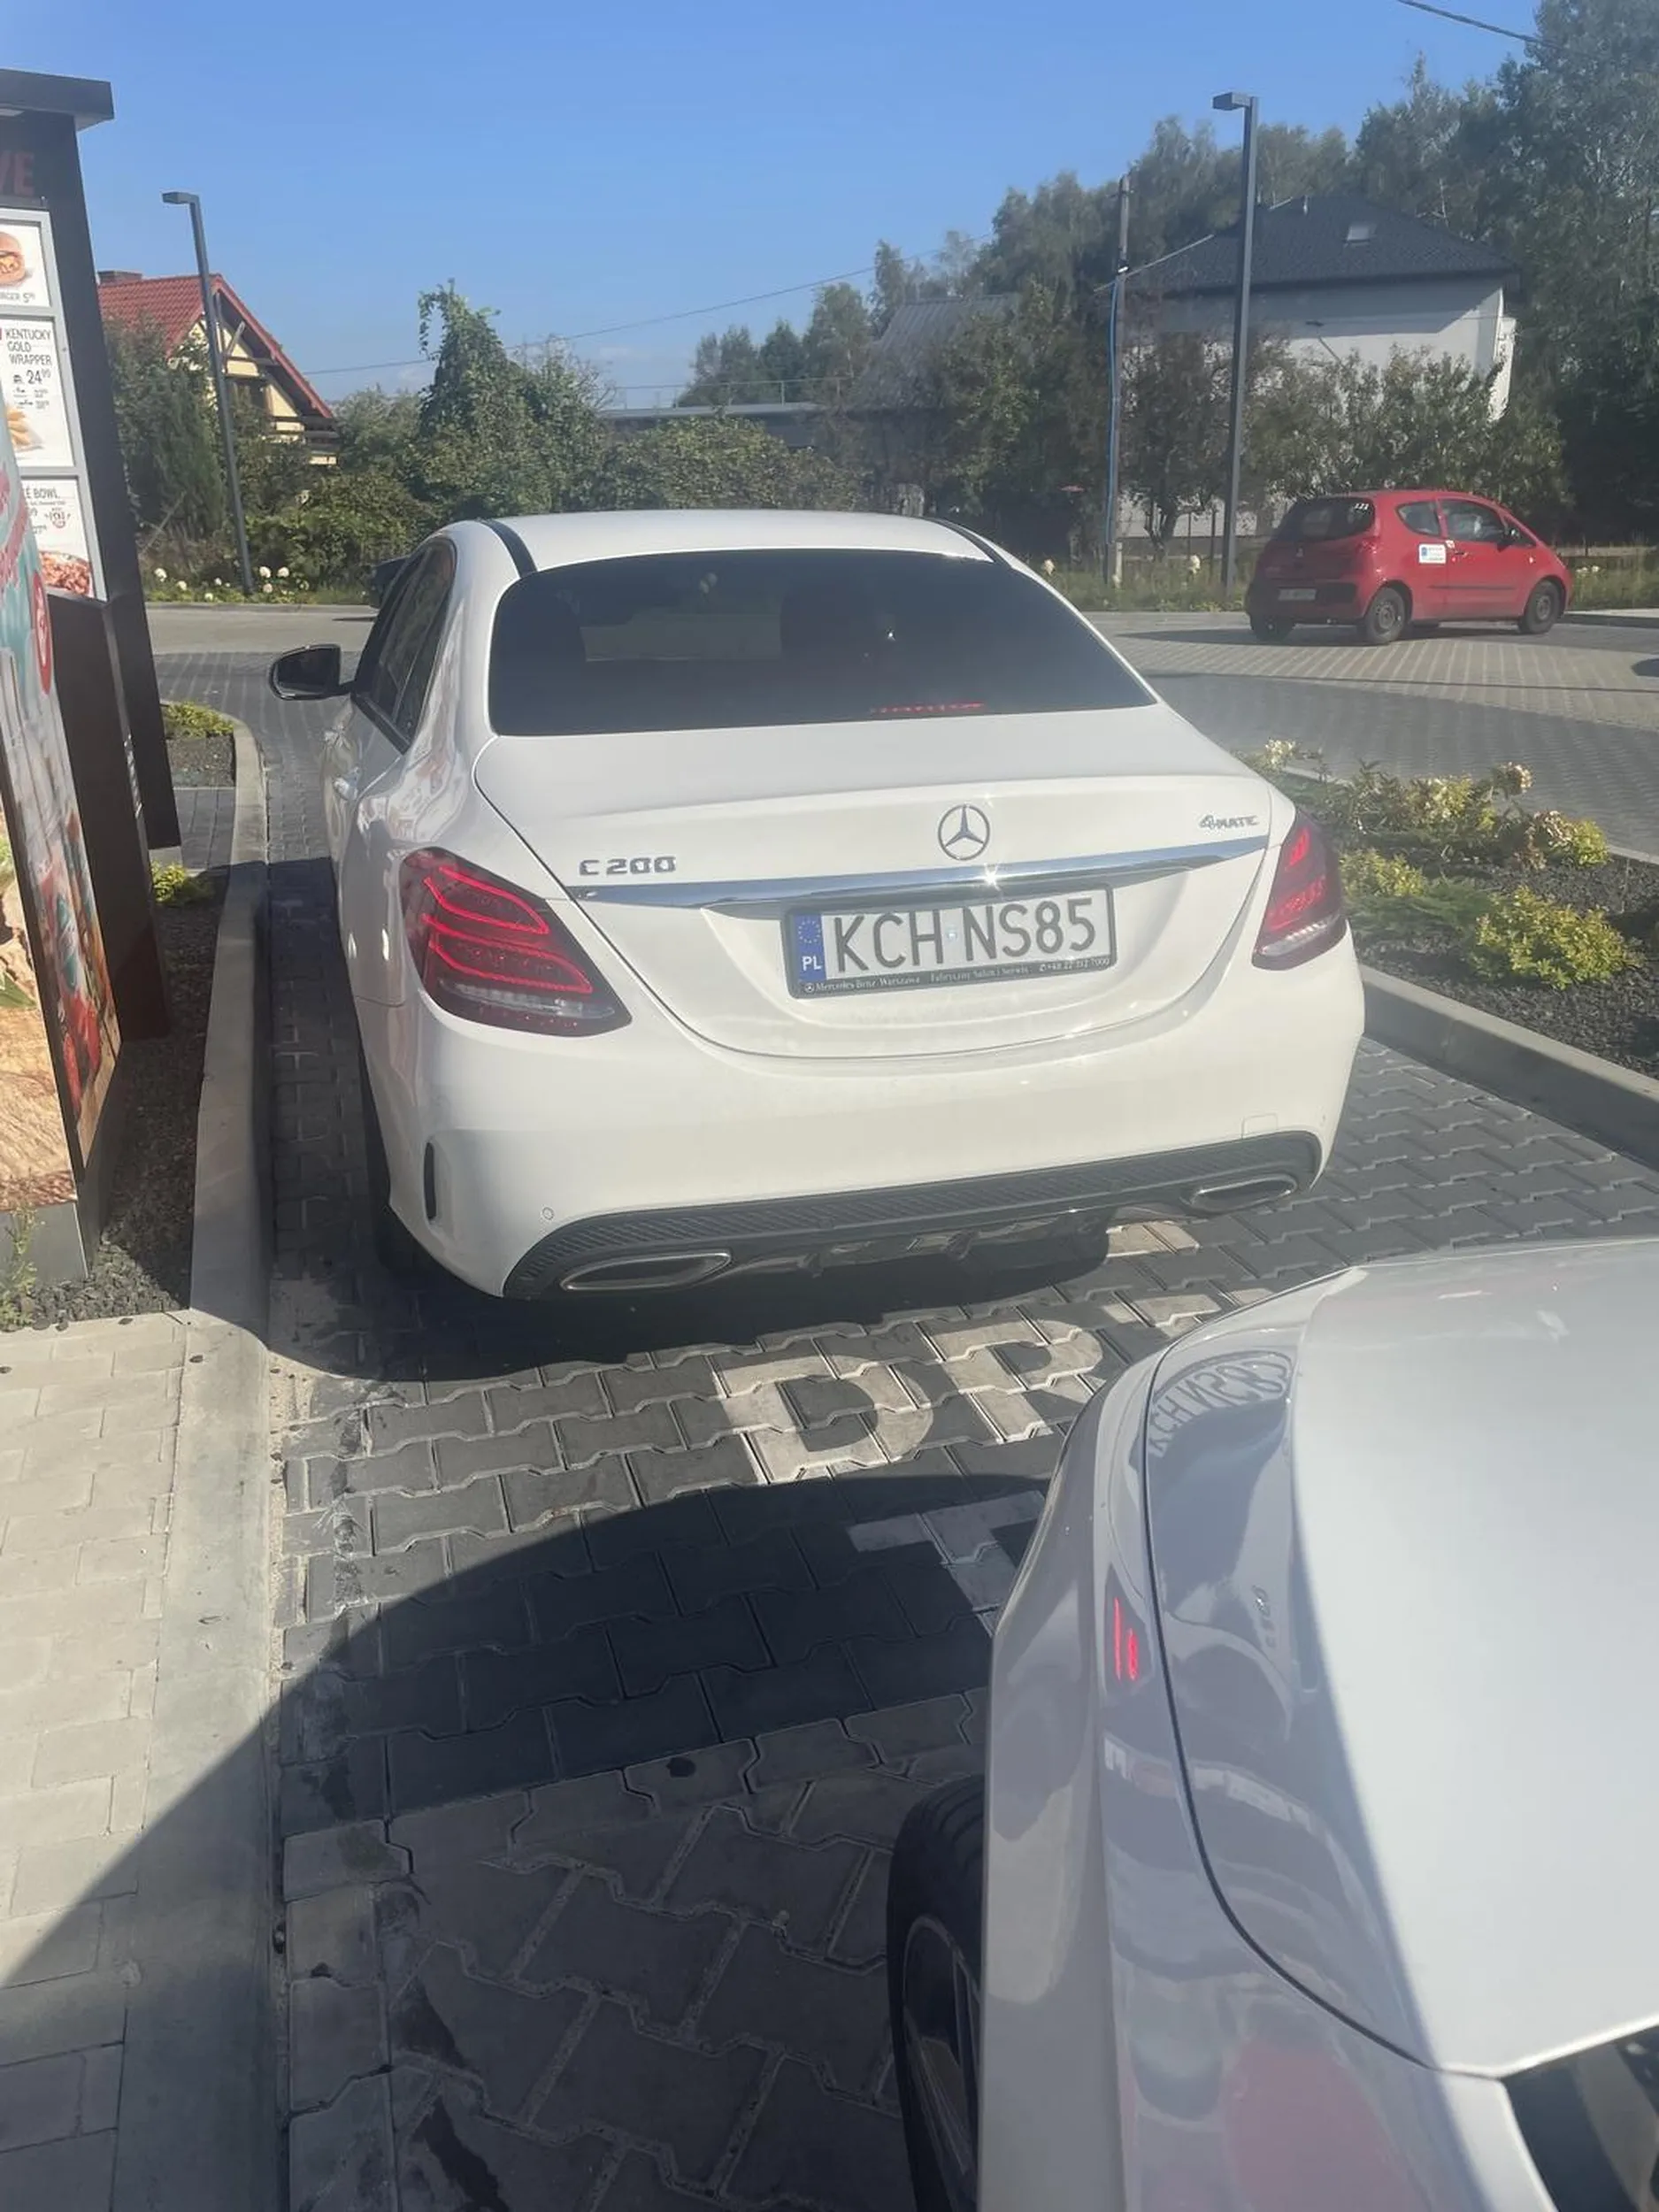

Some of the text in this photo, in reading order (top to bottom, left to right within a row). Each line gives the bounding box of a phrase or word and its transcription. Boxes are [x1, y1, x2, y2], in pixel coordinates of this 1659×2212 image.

[5, 328, 51, 341] KENTUCKY
[7, 342, 32, 352] GOLD
[9, 354, 52, 366] WRAPPER
[579, 856, 676, 876] C 200
[833, 897, 1095, 973] KCH NS85
[802, 956, 822, 972] PL
